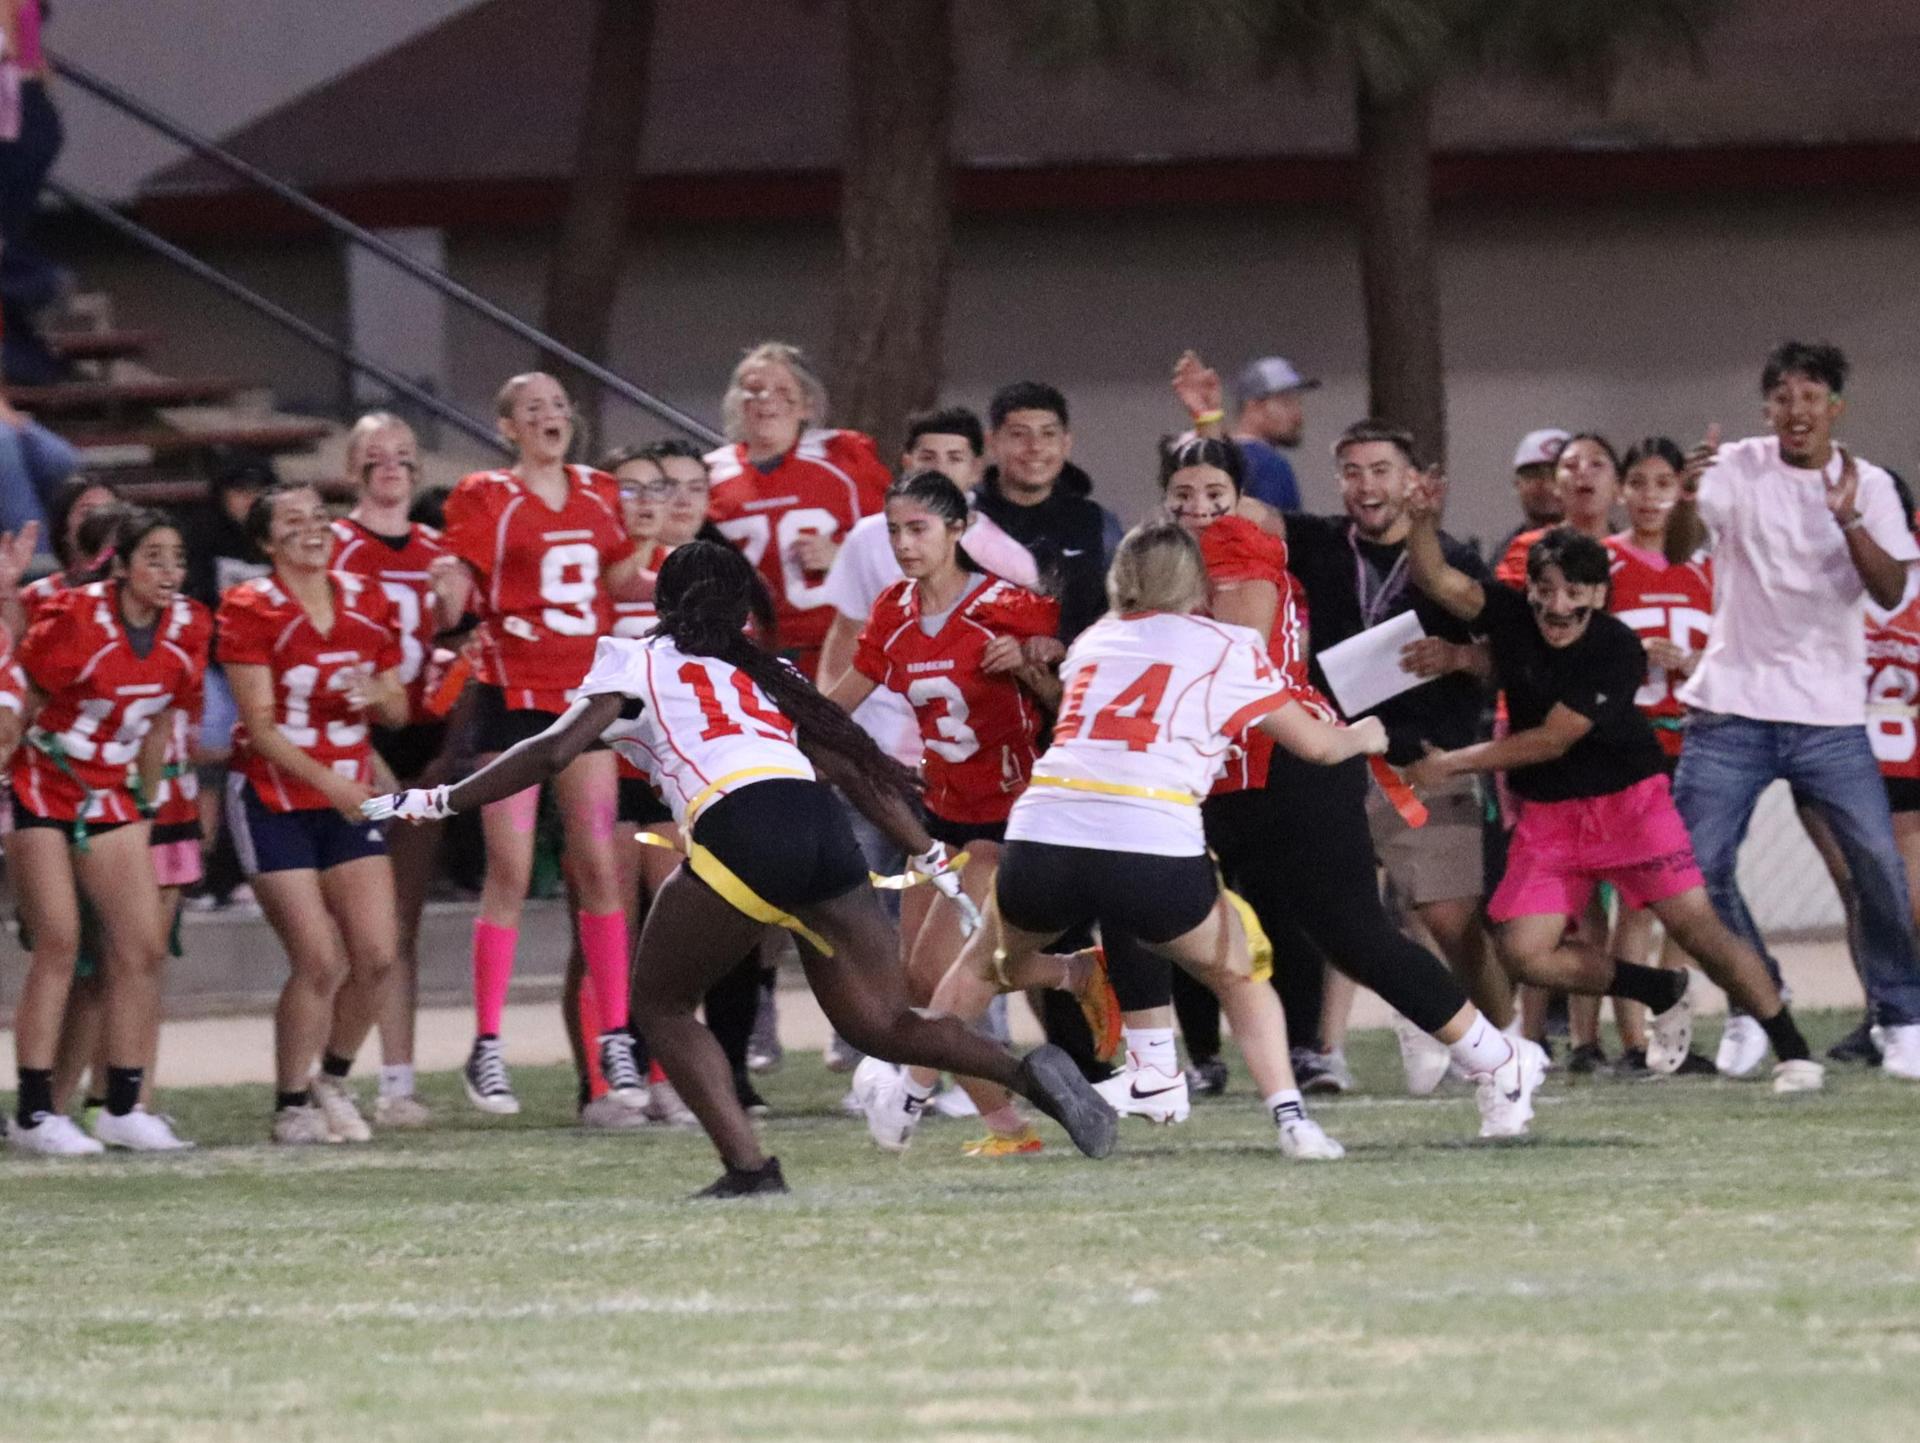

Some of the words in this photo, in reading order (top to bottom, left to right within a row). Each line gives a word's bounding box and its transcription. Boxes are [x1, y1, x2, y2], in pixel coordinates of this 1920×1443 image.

[540, 542, 600, 636] 9
[906, 675, 980, 763] 3
[1052, 662, 1175, 753] 14
